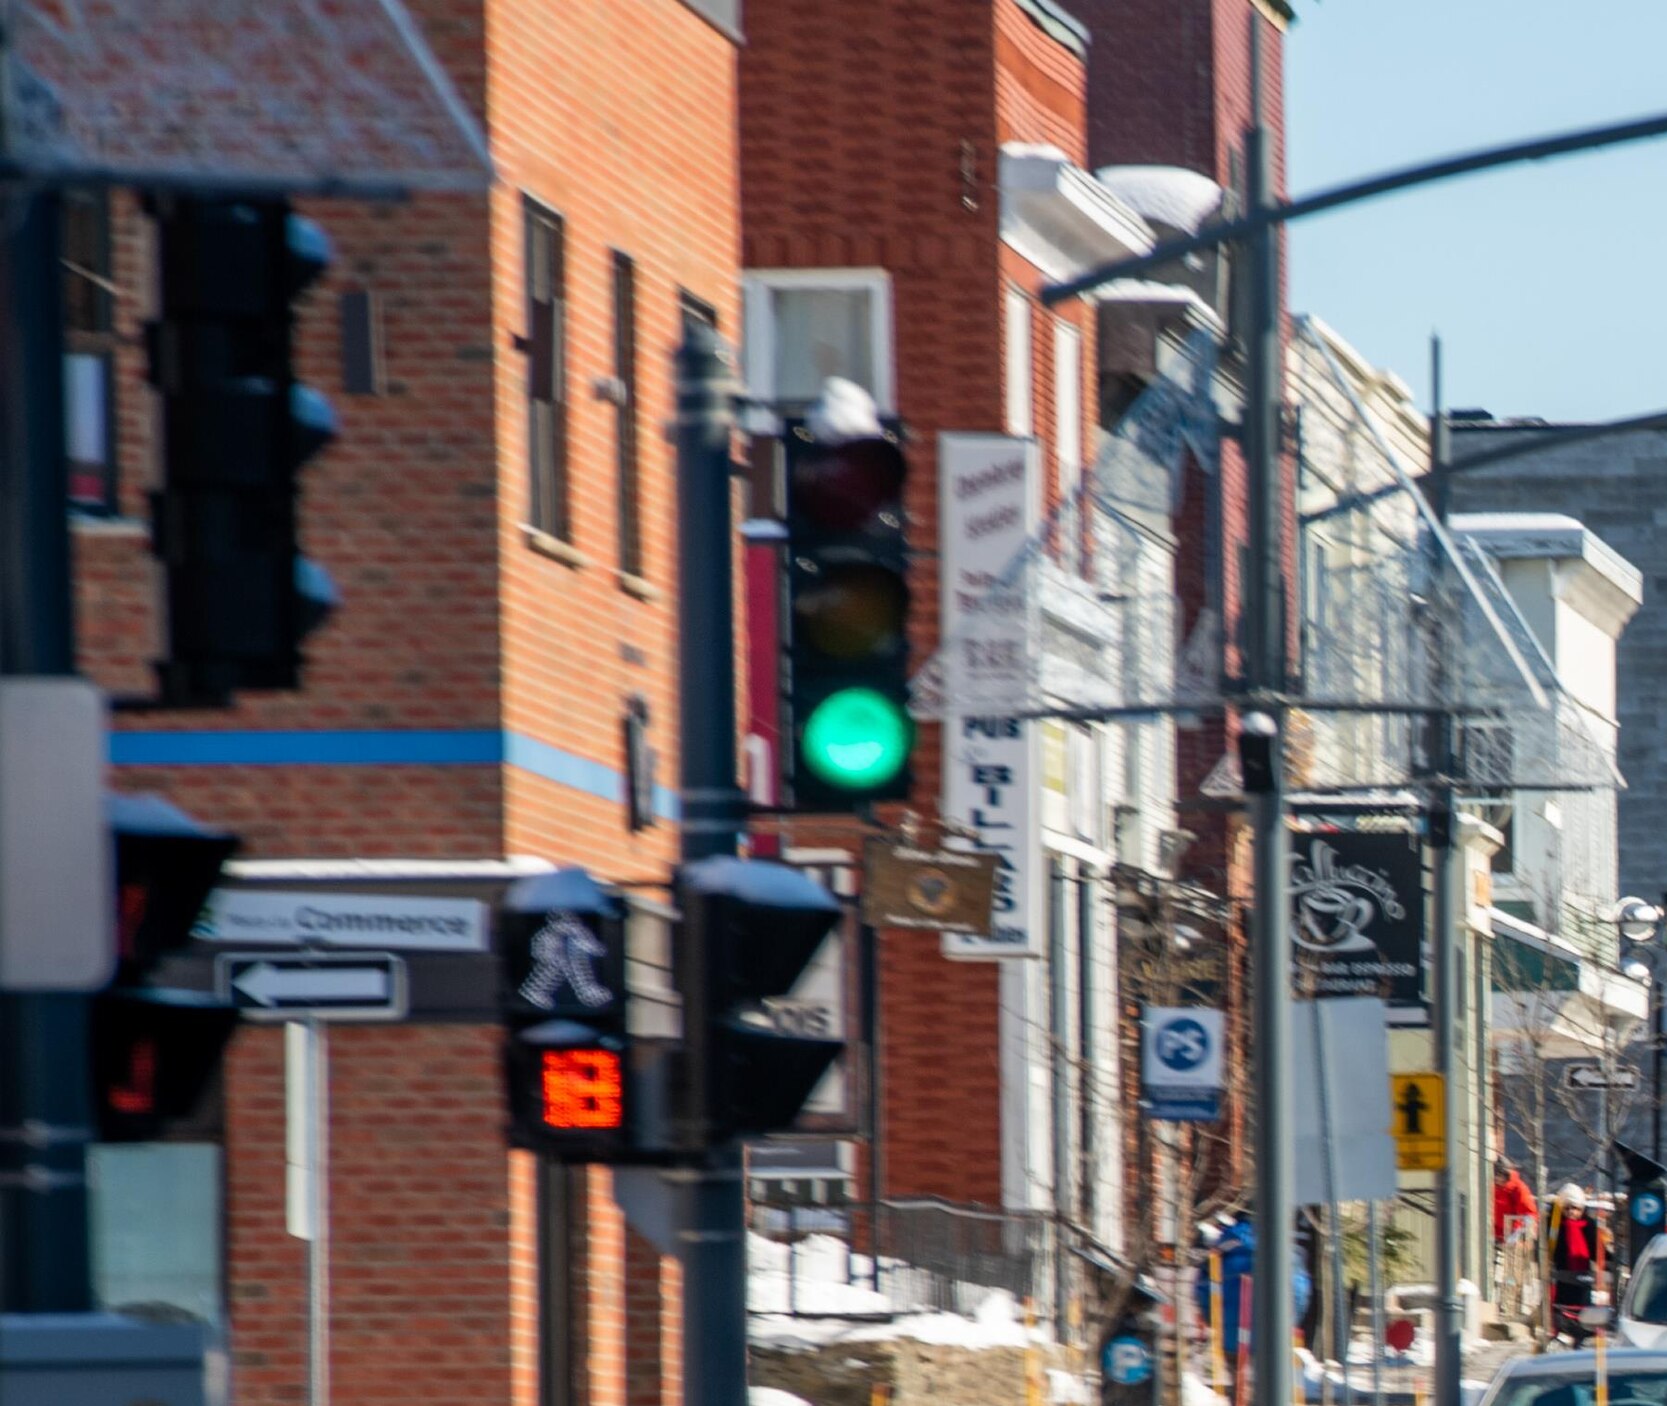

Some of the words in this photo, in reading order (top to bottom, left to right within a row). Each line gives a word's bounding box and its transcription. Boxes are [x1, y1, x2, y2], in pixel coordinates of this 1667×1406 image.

[295, 905, 468, 937] Commerce
[1638, 1198, 1660, 1222] P
[1111, 1342, 1144, 1380] P
